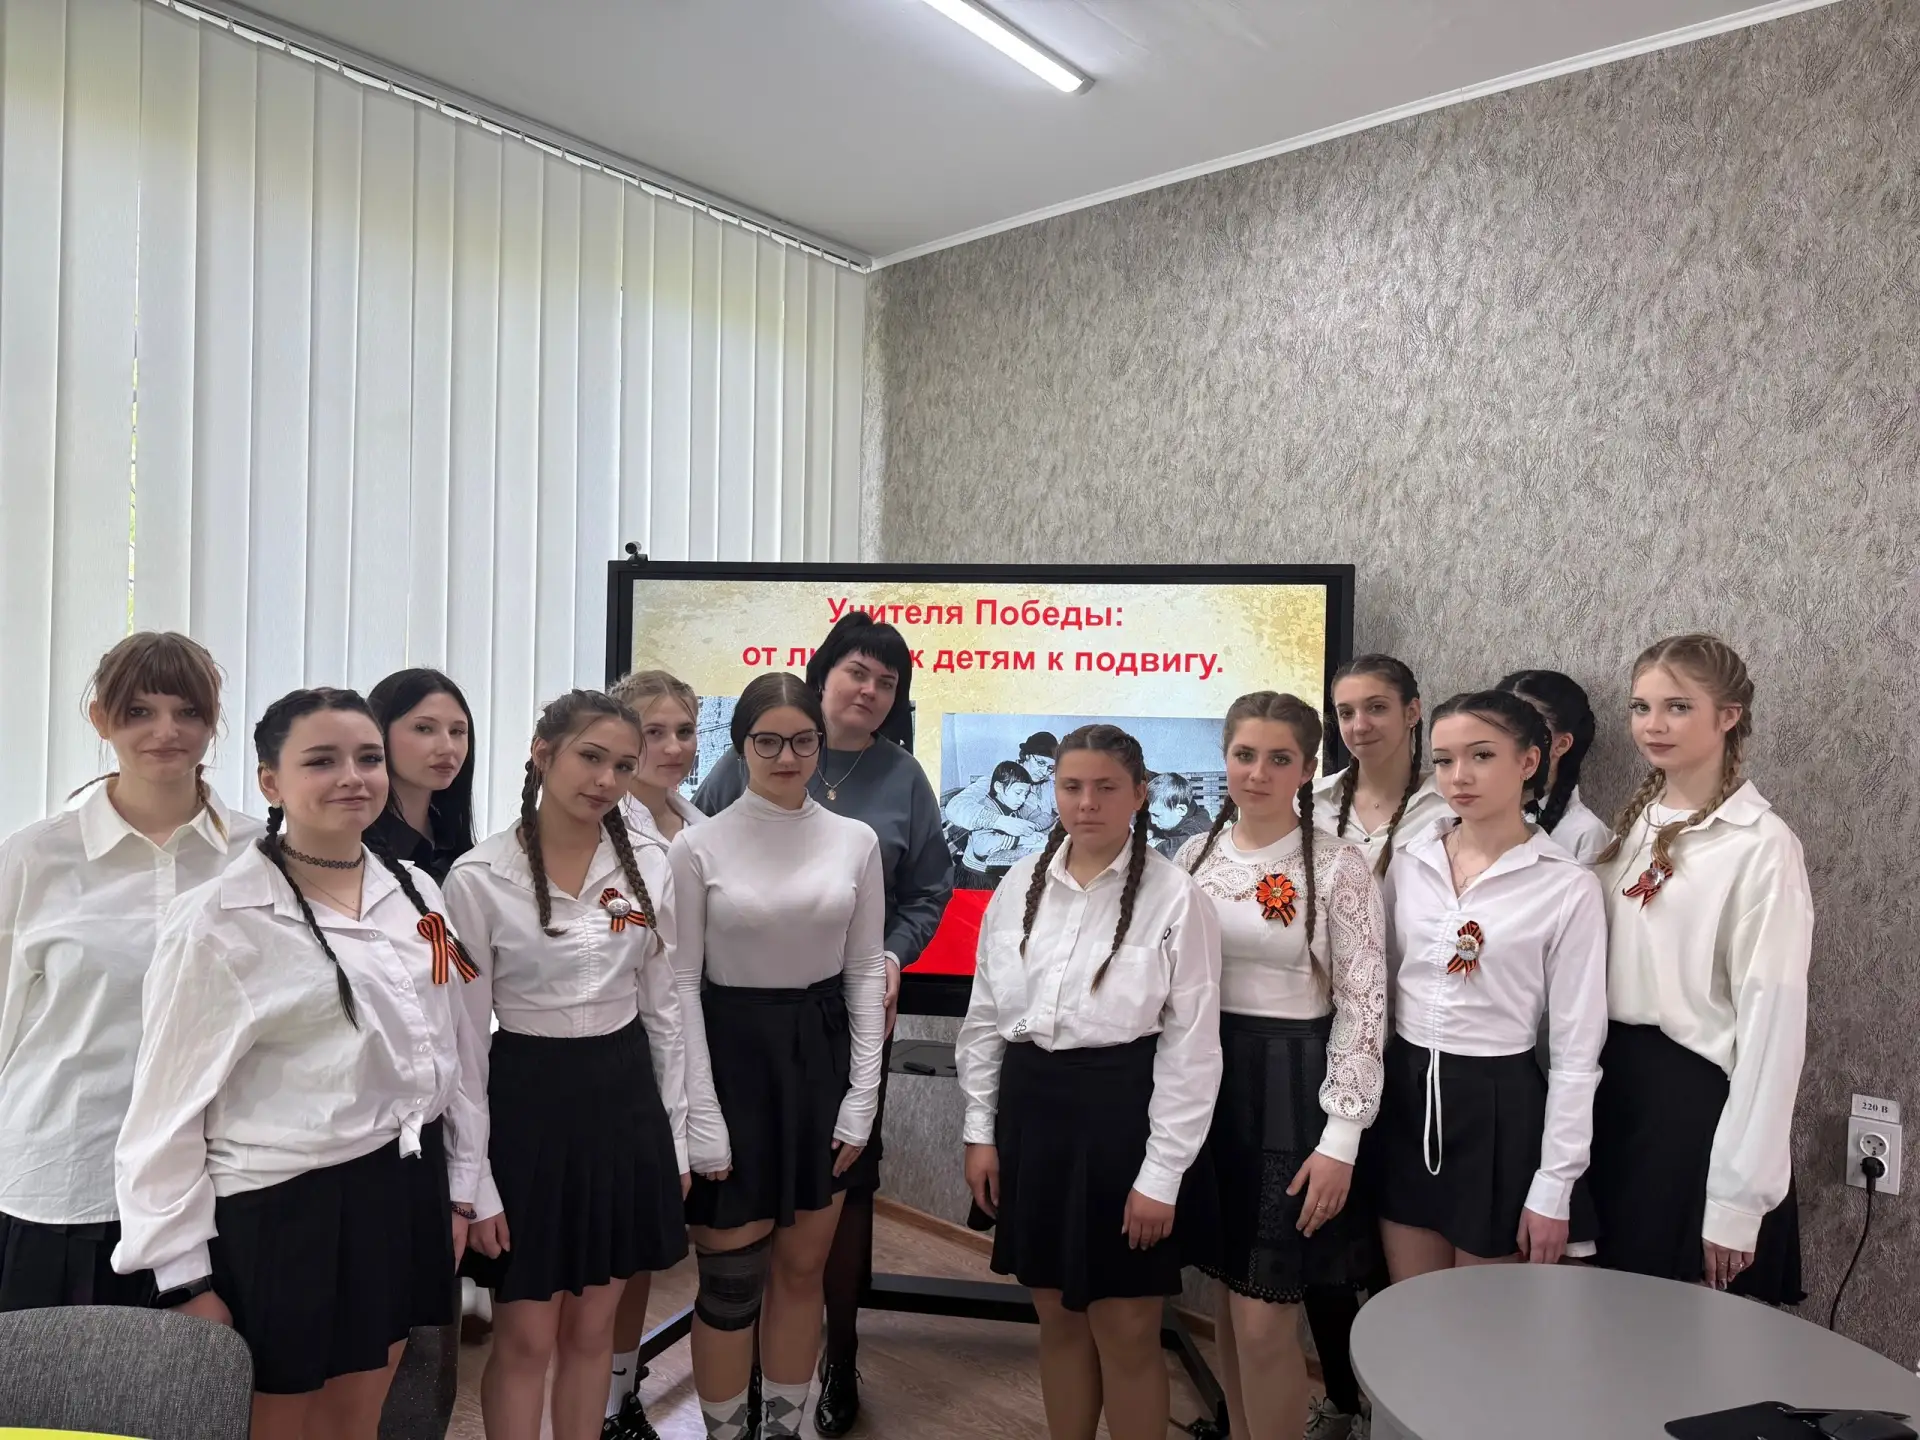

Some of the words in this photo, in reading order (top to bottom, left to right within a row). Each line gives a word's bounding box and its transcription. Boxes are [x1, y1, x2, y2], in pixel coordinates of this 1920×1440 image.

[976, 599, 1123, 631] Победы:
[742, 646, 778, 667] от
[909, 649, 925, 669] к
[932, 649, 1036, 674] детям
[1048, 651, 1064, 671] к
[1075, 652, 1224, 681] подвигу.
[1861, 1102, 1878, 1112] 220
